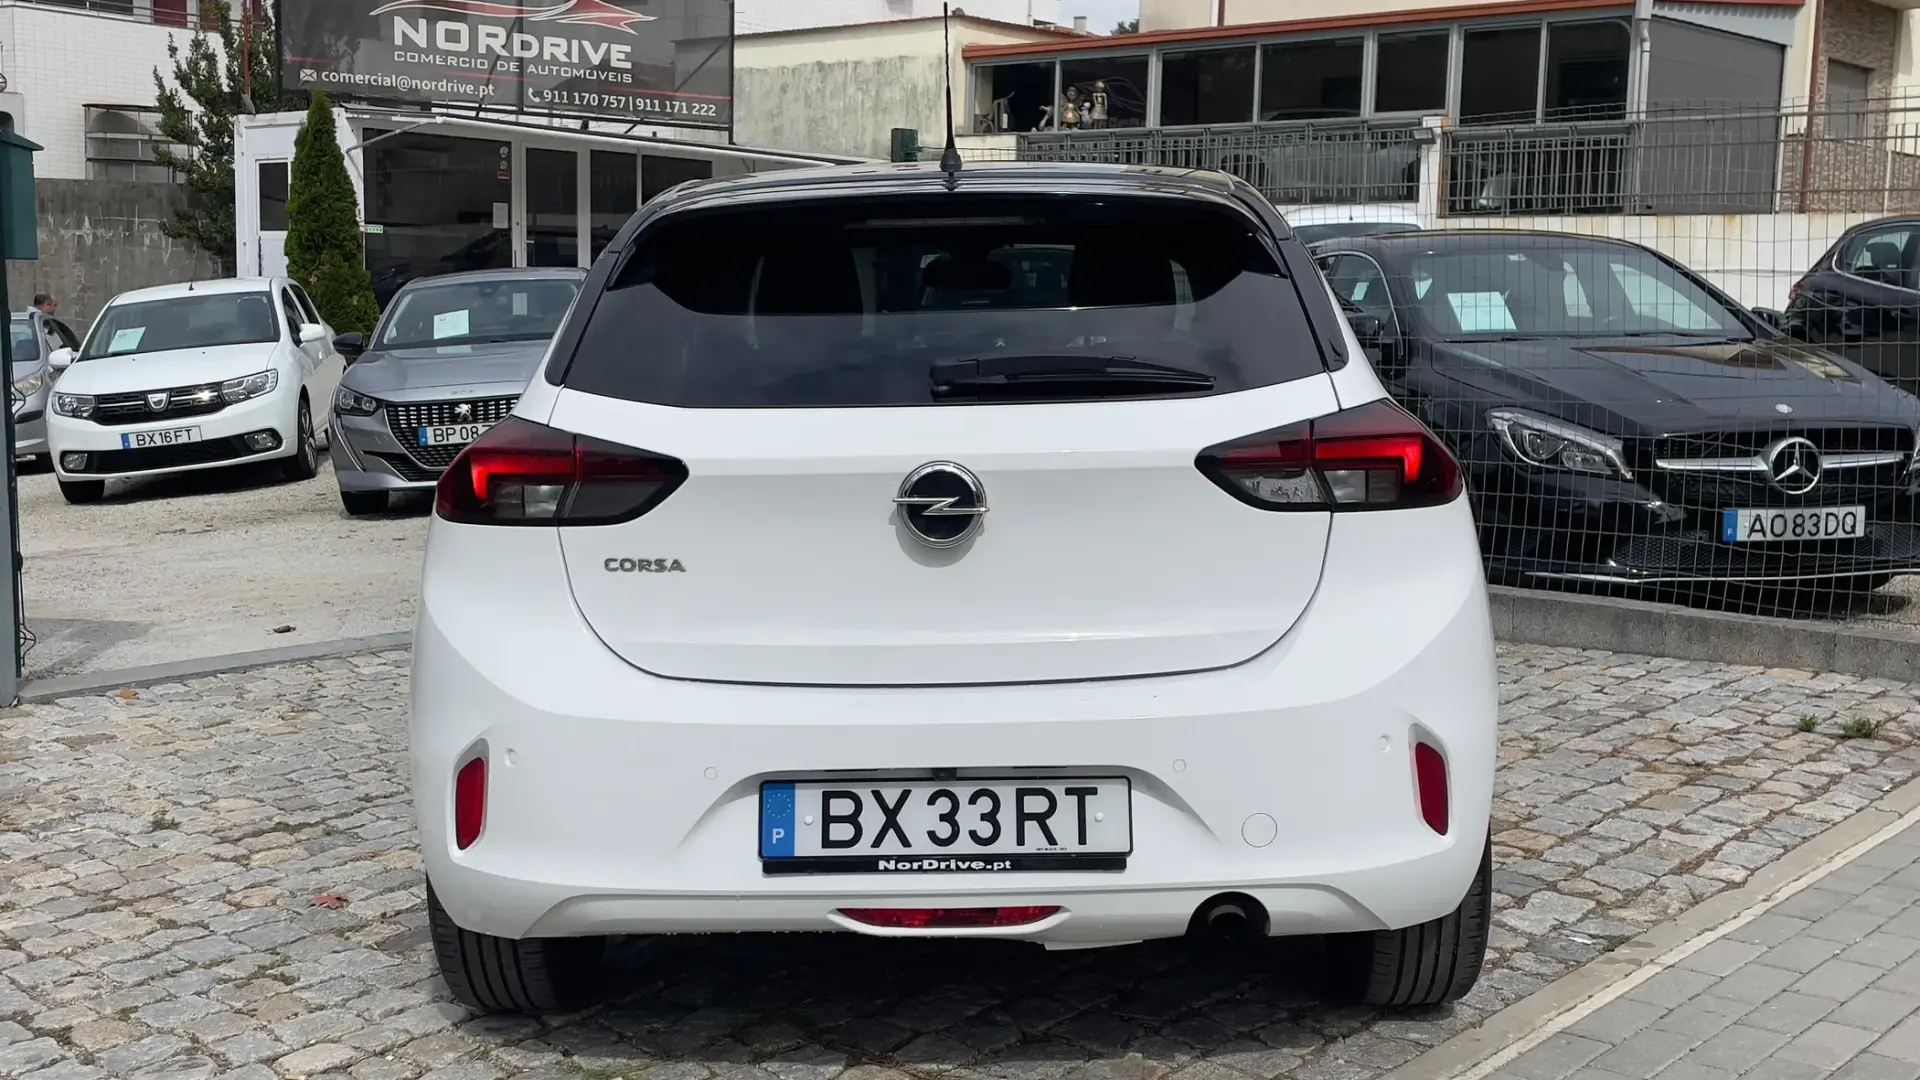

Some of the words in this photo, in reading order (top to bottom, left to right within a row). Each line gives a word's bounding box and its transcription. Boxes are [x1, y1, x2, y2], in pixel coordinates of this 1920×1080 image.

[394, 15, 632, 69] NORDRIVE
[497, 61, 520, 72] DE
[321, 69, 495, 97] comercial@nordrive.pt
[543, 90, 569, 104] 911
[573, 92, 598, 106] 170
[602, 95, 626, 109] 757
[637, 100, 661, 112] 911
[665, 102, 688, 114] 171
[692, 103, 717, 116] 222
[604, 558, 687, 573] CORSA
[772, 828, 785, 844] P
[878, 858, 1012, 872] NorDrive.pt
